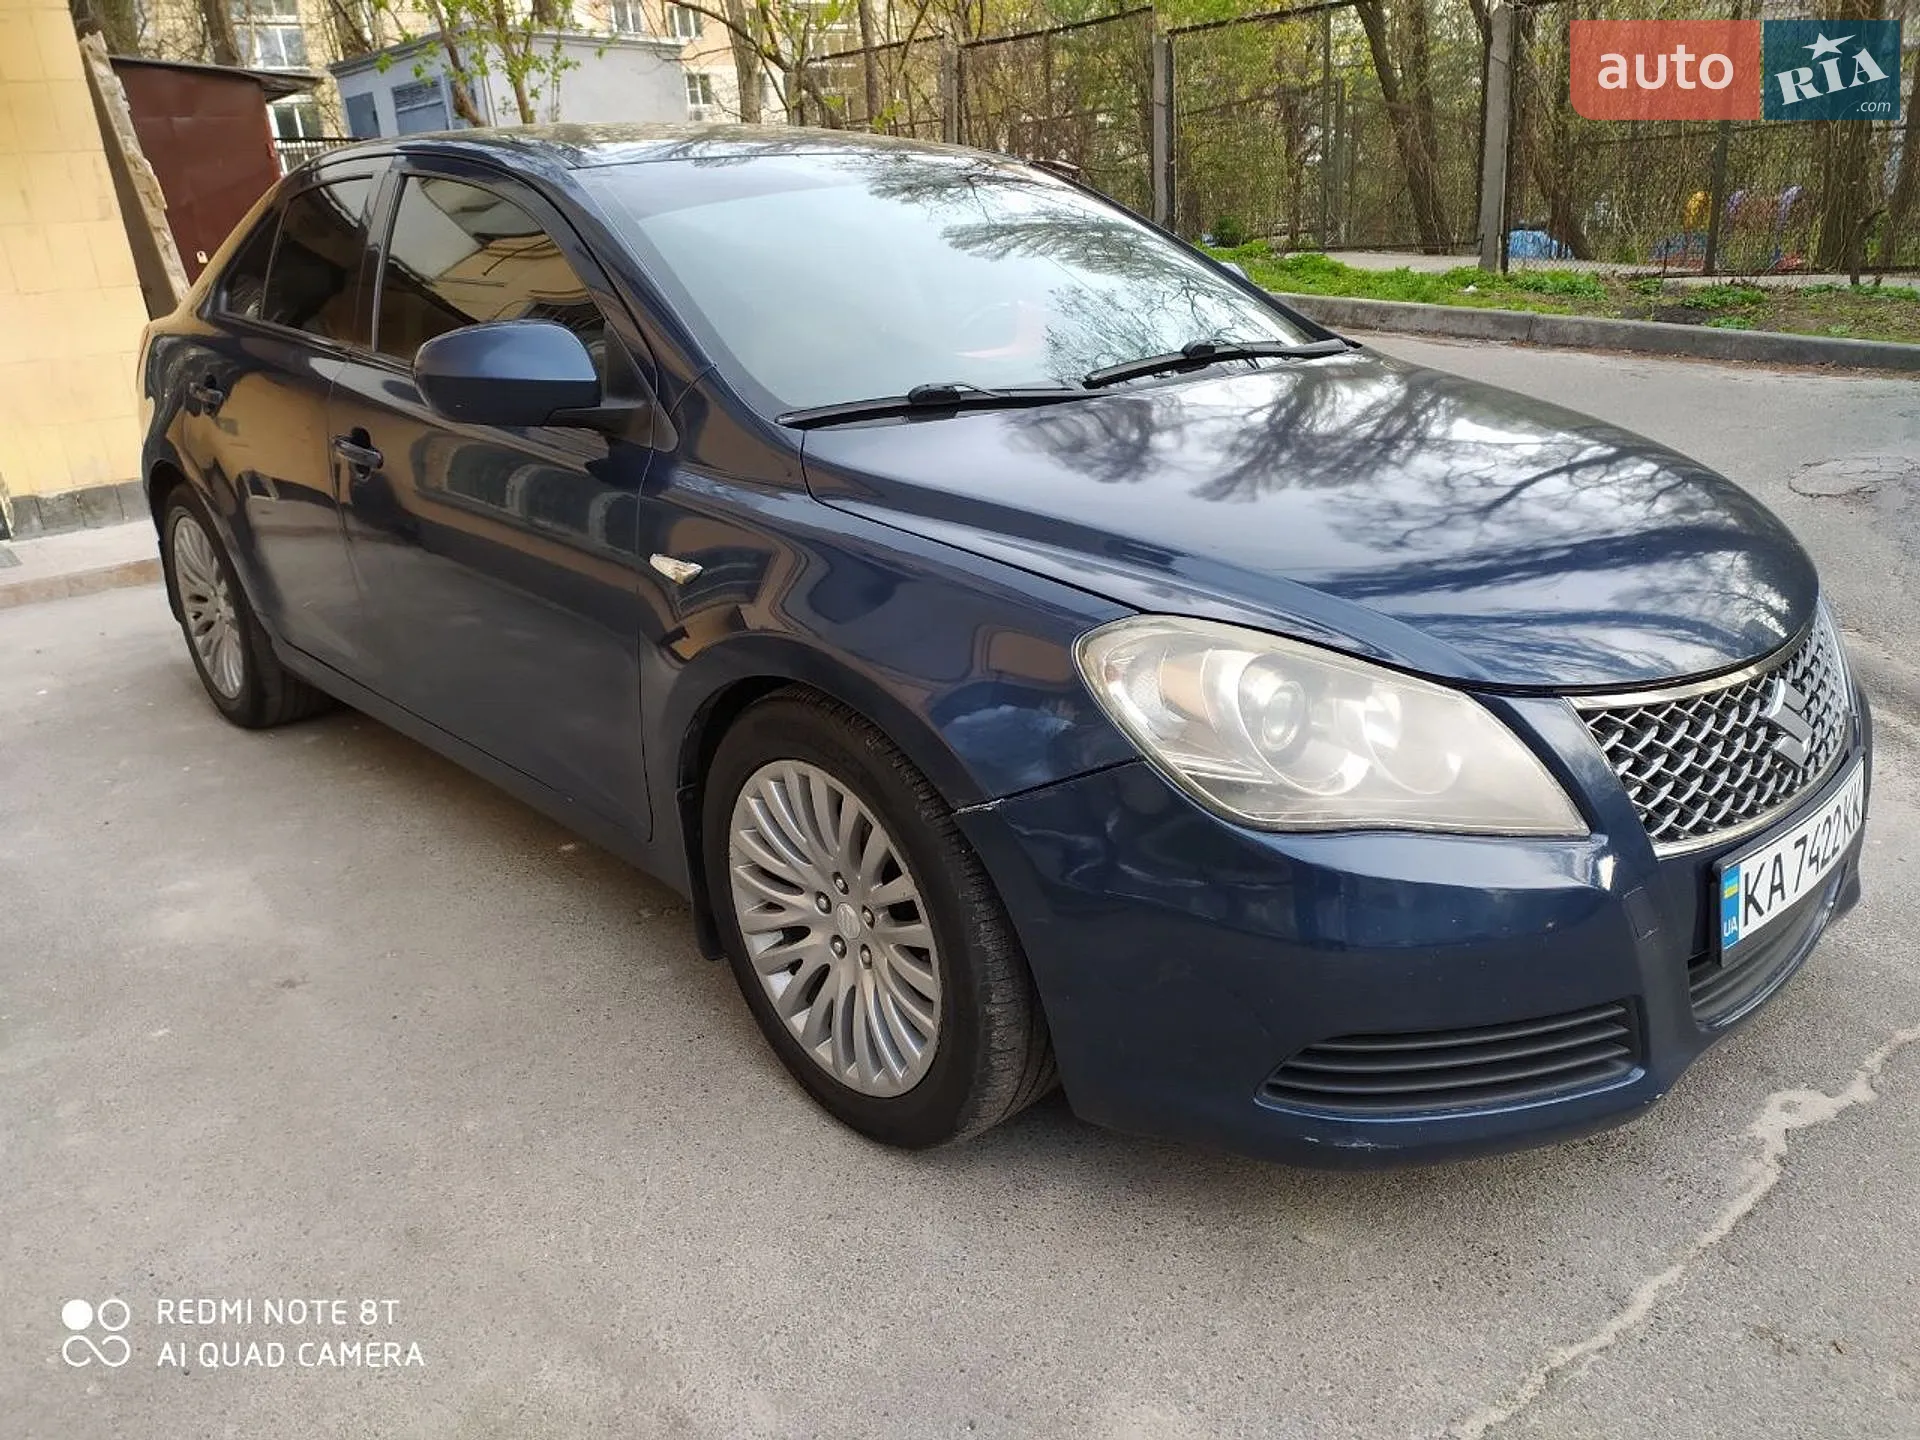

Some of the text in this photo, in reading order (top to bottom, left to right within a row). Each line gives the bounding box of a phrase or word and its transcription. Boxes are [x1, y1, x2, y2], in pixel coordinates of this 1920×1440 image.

[1743, 852, 1786, 927] KA
[1794, 804, 1842, 893] 7422
[1723, 916, 1738, 938] UA
